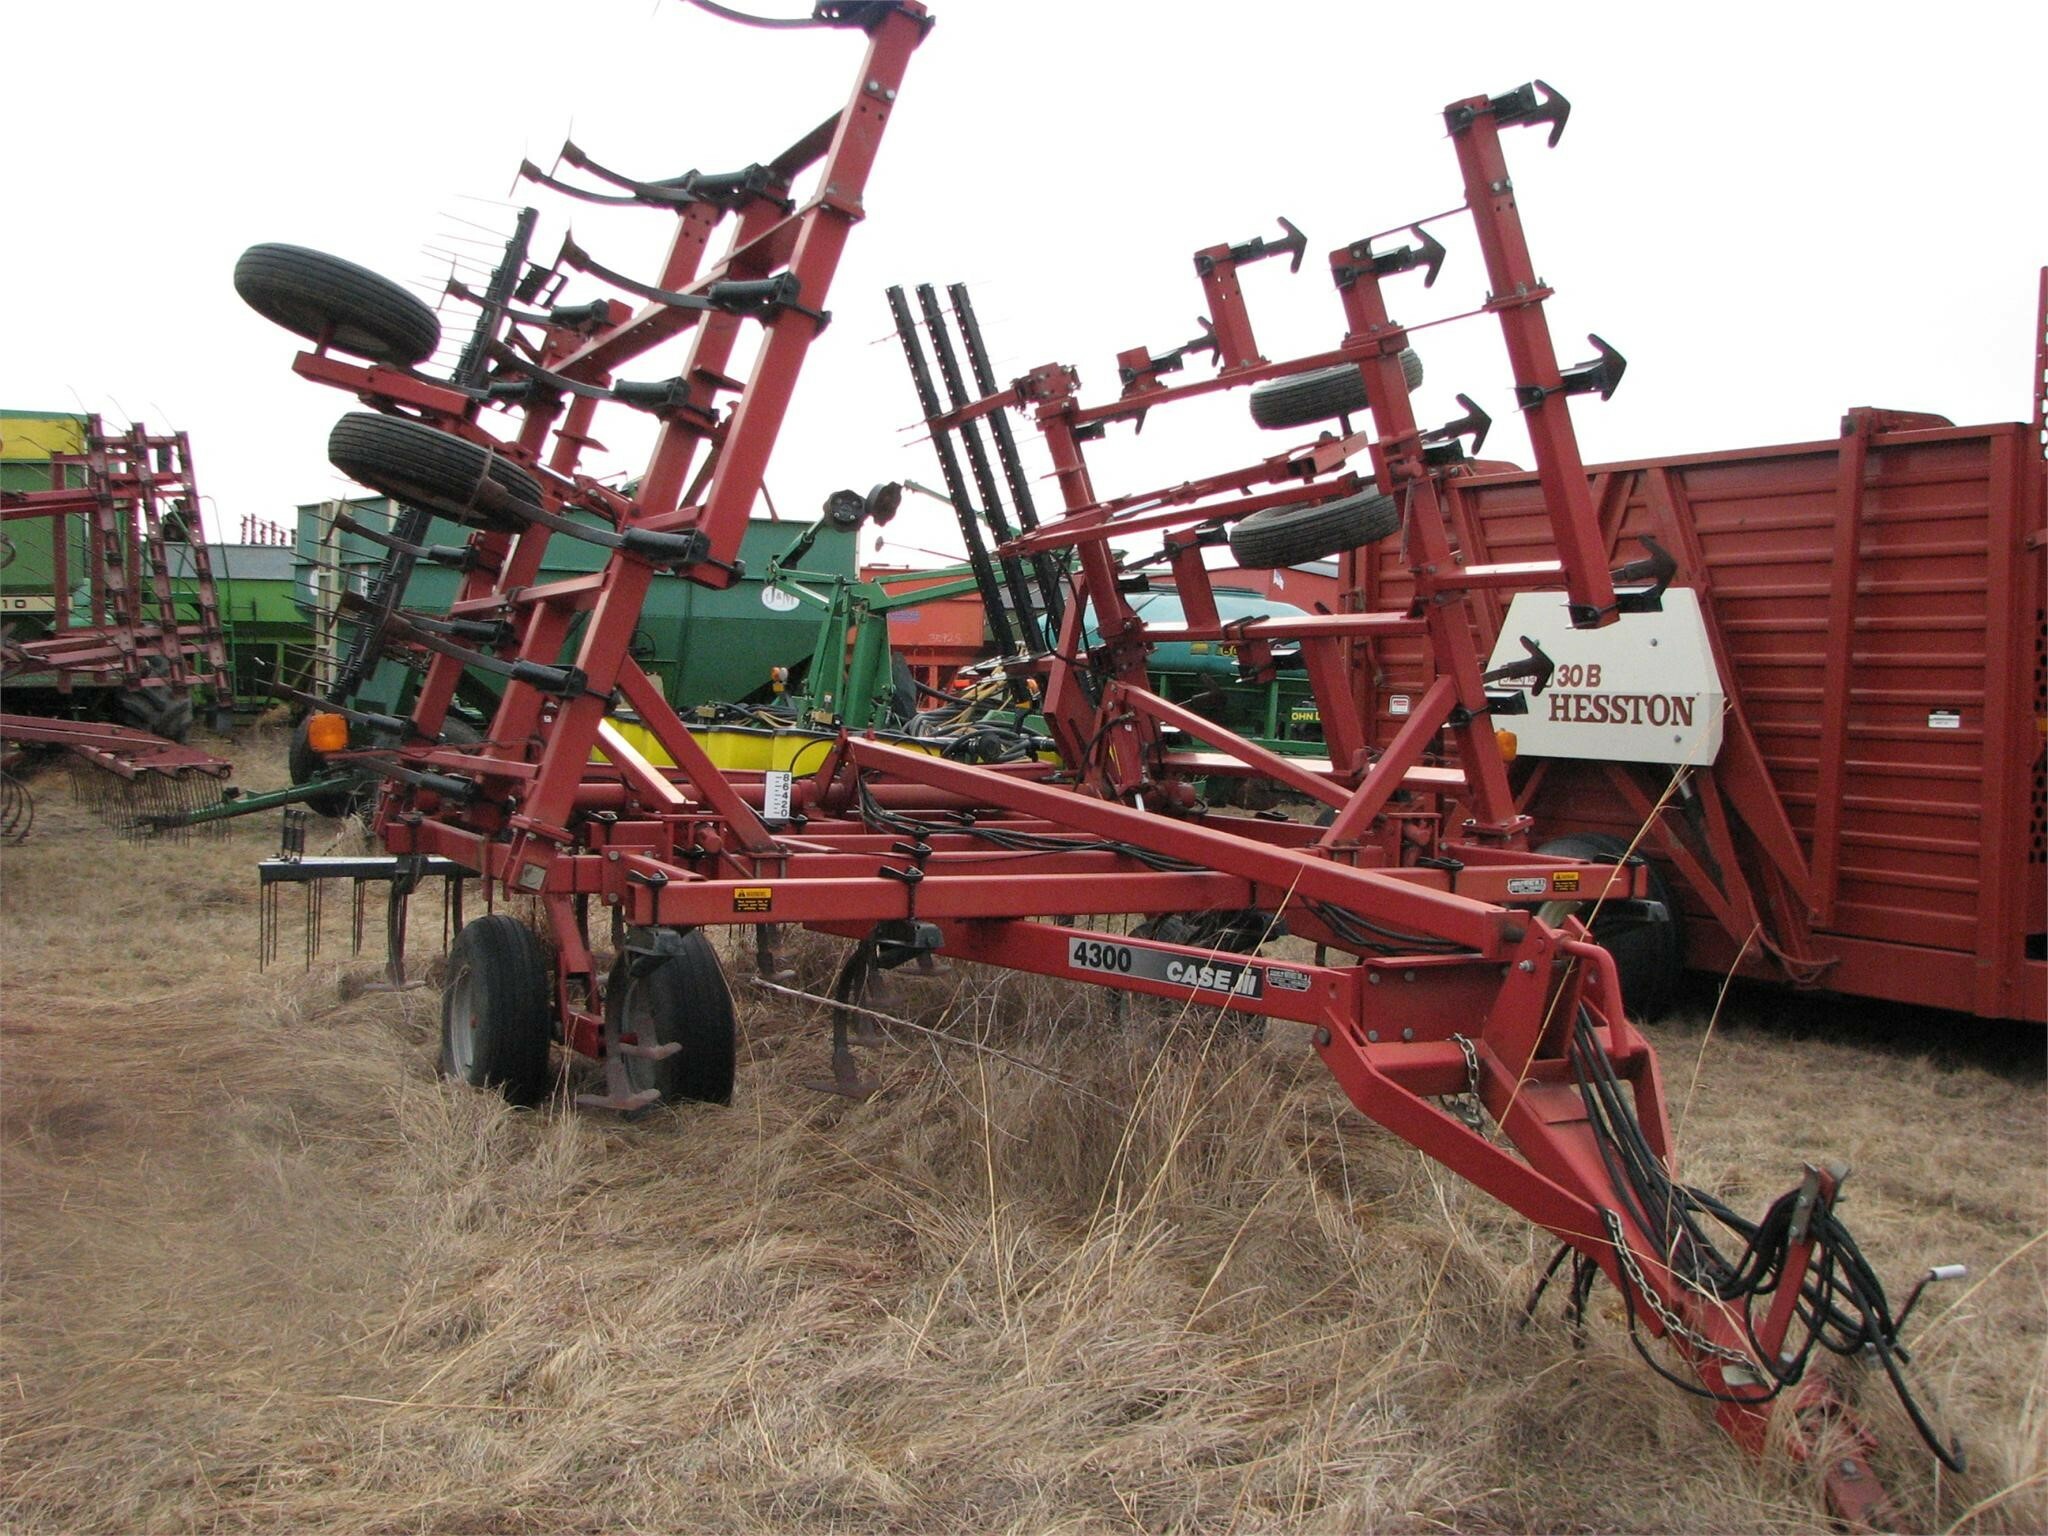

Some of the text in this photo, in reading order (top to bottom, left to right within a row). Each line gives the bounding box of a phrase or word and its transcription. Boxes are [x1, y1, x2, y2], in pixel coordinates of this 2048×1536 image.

[1548, 693, 1695, 727] HESSTON
[1291, 711, 1314, 721] OHN
[783, 773, 790, 782] 8
[782, 783, 789, 791] 6
[781, 800, 788, 809] 2
[1074, 941, 1132, 973] 4300
[1166, 960, 1232, 991] CASE
